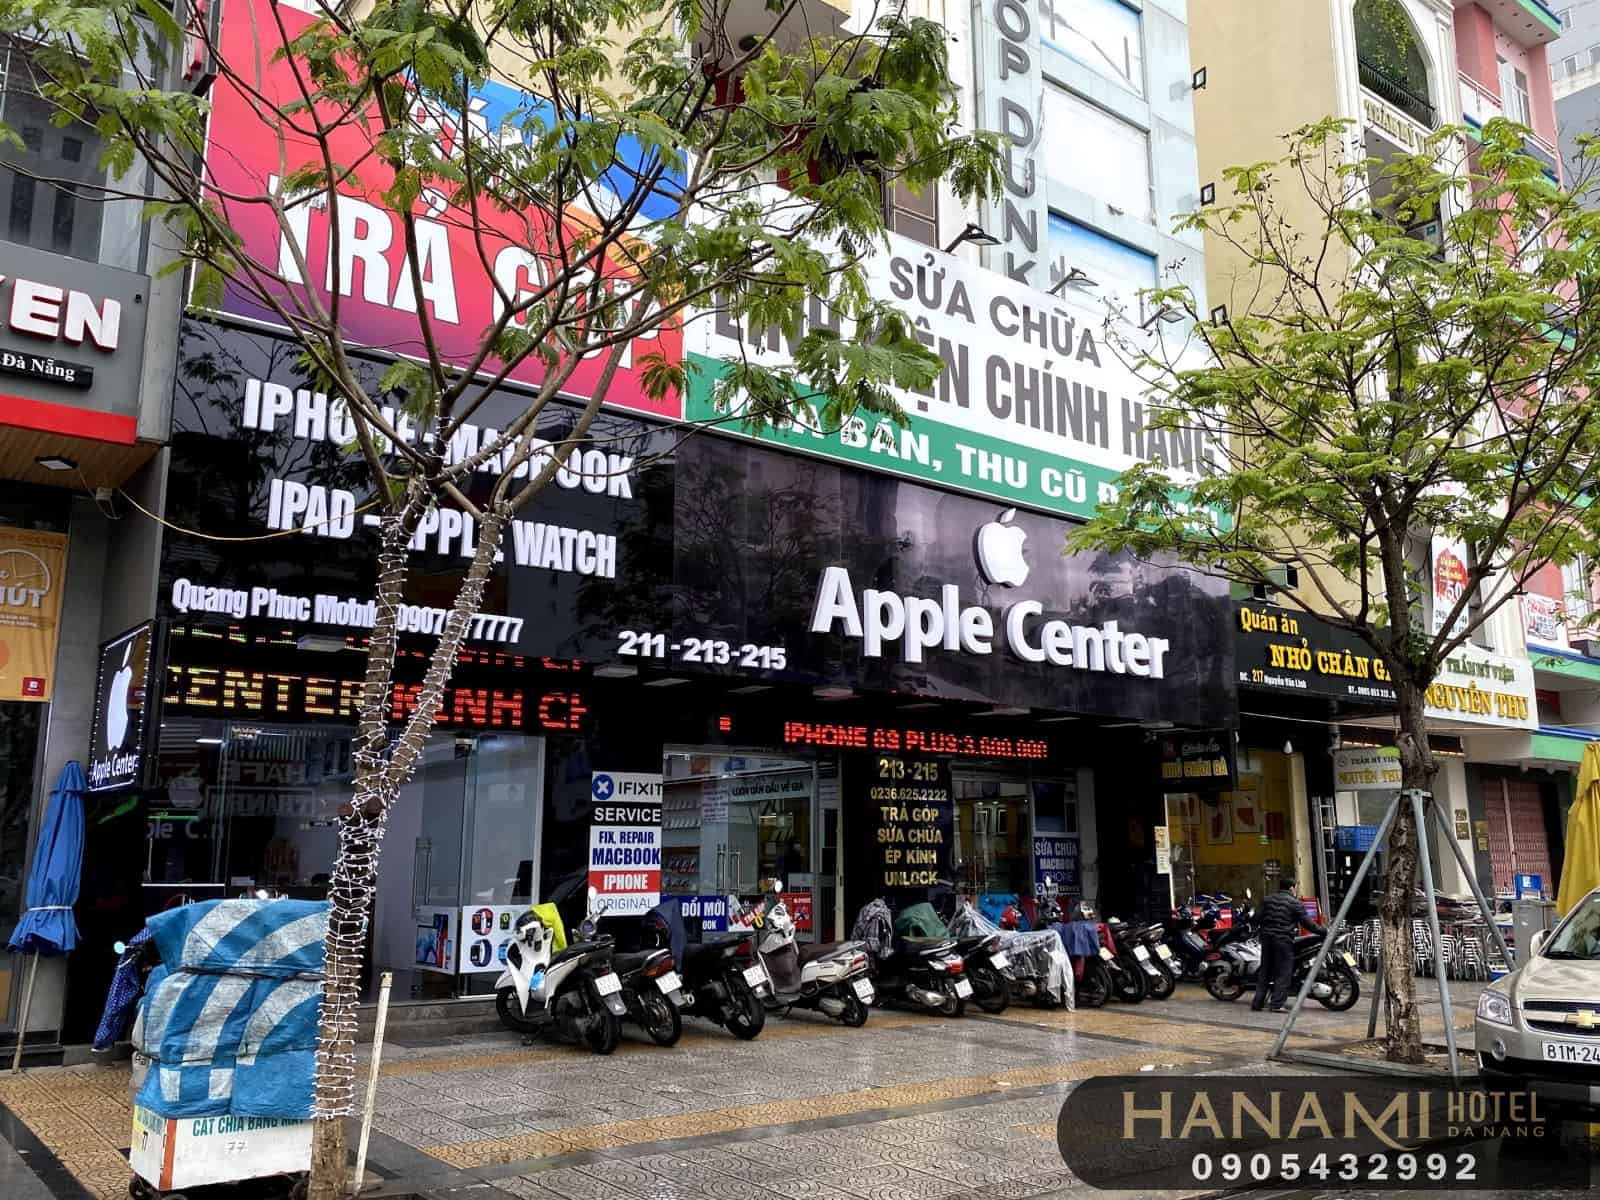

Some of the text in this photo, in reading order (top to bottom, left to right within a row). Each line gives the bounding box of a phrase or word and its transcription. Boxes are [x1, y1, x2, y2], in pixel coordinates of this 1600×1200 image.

[269, 173, 460, 326] TRẢ
[0, 274, 121, 350] EN
[889, 252, 1102, 369] SỬA CHỮA
[2, 353, 75, 382] Đà Nẵng
[986, 353, 1109, 450] CHÍNH
[956, 442, 1028, 489] THU
[1041, 466, 1087, 504] CŨ
[267, 478, 355, 539] IPAD
[406, 507, 504, 563] PPL
[512, 520, 617, 580] WATCH
[172, 577, 248, 619] Quang
[250, 586, 311, 621] Phuc
[313, 594, 380, 630] Mobil
[398, 602, 524, 643] 09077777
[1240, 606, 1298, 635] Quán ăn
[811, 566, 1170, 680] Apple Center
[1269, 637, 1312, 671] NHỎ
[1317, 649, 1369, 678] CHÂN
[1495, 692, 1529, 720] THU
[784, 722, 867, 747] IPHONE
[618, 781, 663, 796] IFIXIT
[594, 807, 662, 822] SERVICE
[880, 802, 939, 822] TRẢ GÓP
[619, 831, 654, 844] REPAIR
[877, 823, 943, 844] SỬA CHỮA
[592, 848, 660, 865] MACBOOK
[885, 846, 937, 864] ÉP KÍNH
[603, 874, 648, 890] IPHONE
[884, 870, 938, 886] UNLOCK
[597, 898, 652, 910] ORIGINAL
[703, 896, 725, 917] MỚI
[217, 1116, 244, 1135] CHIA
